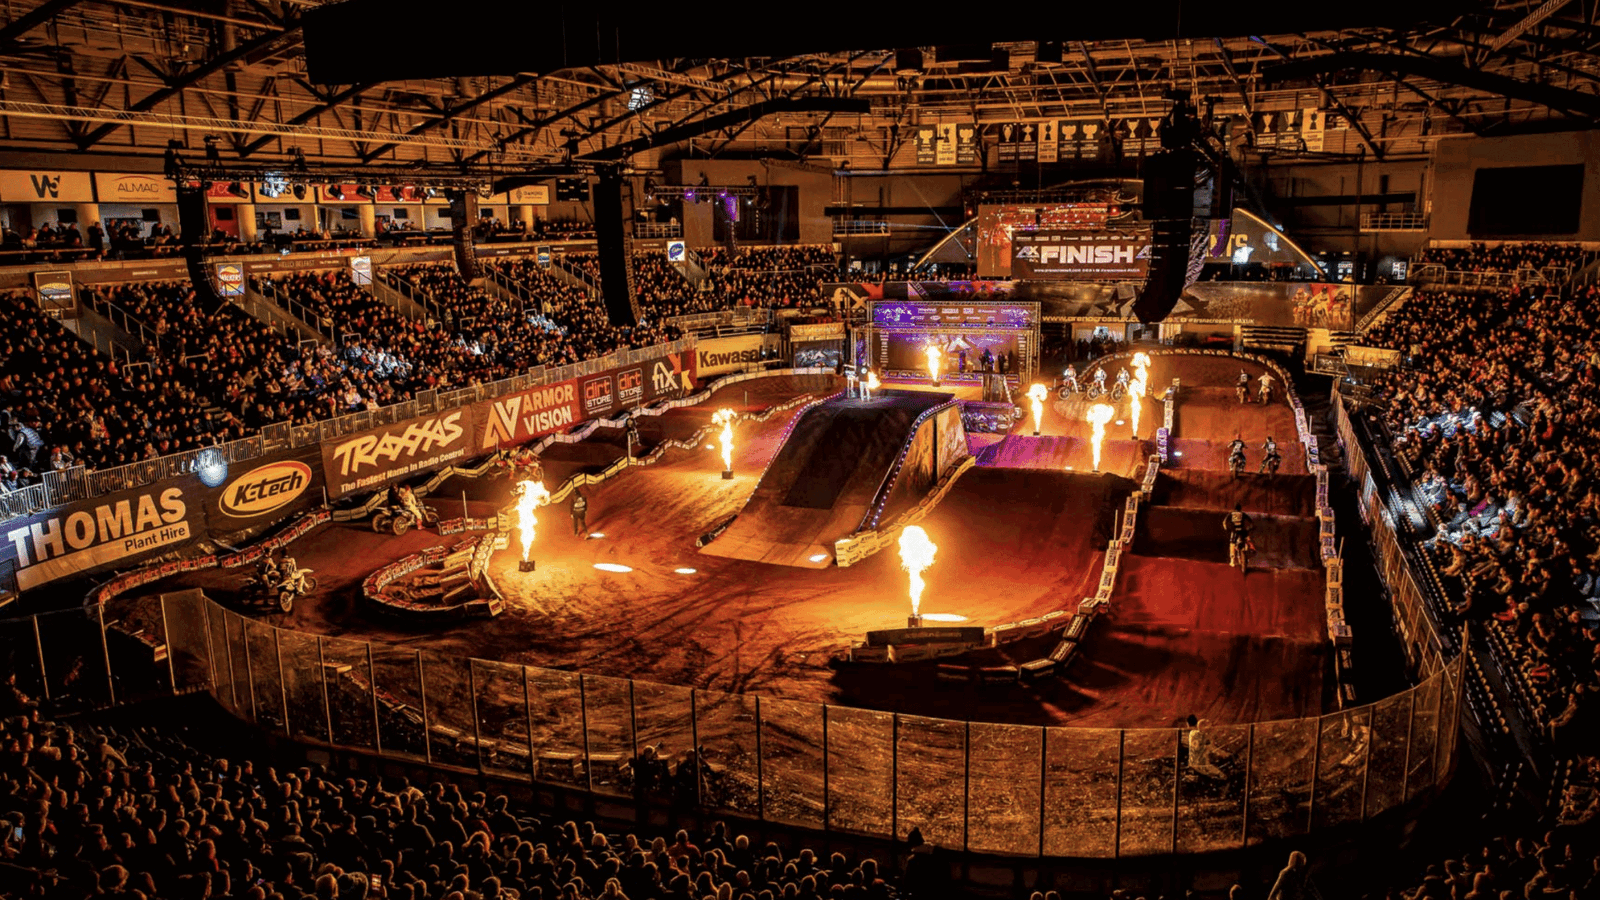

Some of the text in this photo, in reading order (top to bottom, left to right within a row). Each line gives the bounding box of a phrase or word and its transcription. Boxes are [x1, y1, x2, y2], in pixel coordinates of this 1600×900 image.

[117, 183, 159, 193] ALMAC
[1041, 245, 1134, 264] FINISH
[1042, 316, 1140, 324] www.arenacrossuk.c
[585, 380, 610, 400] dirt
[619, 371, 641, 391] dirt
[620, 386, 643, 399] STORE
[522, 384, 575, 414] ARMOR
[586, 394, 612, 408] STORE
[523, 405, 573, 435] VISION
[333, 411, 464, 476] TRAXXAS
[340, 482, 356, 493] The
[356, 471, 387, 487] Fastest
[386, 465, 409, 479] Name
[418, 455, 439, 468] Radio
[439, 449, 465, 463] Control
[233, 470, 304, 507] K-tech
[7, 487, 187, 568] THOMAS
[124, 525, 186, 552] Plant Hire
